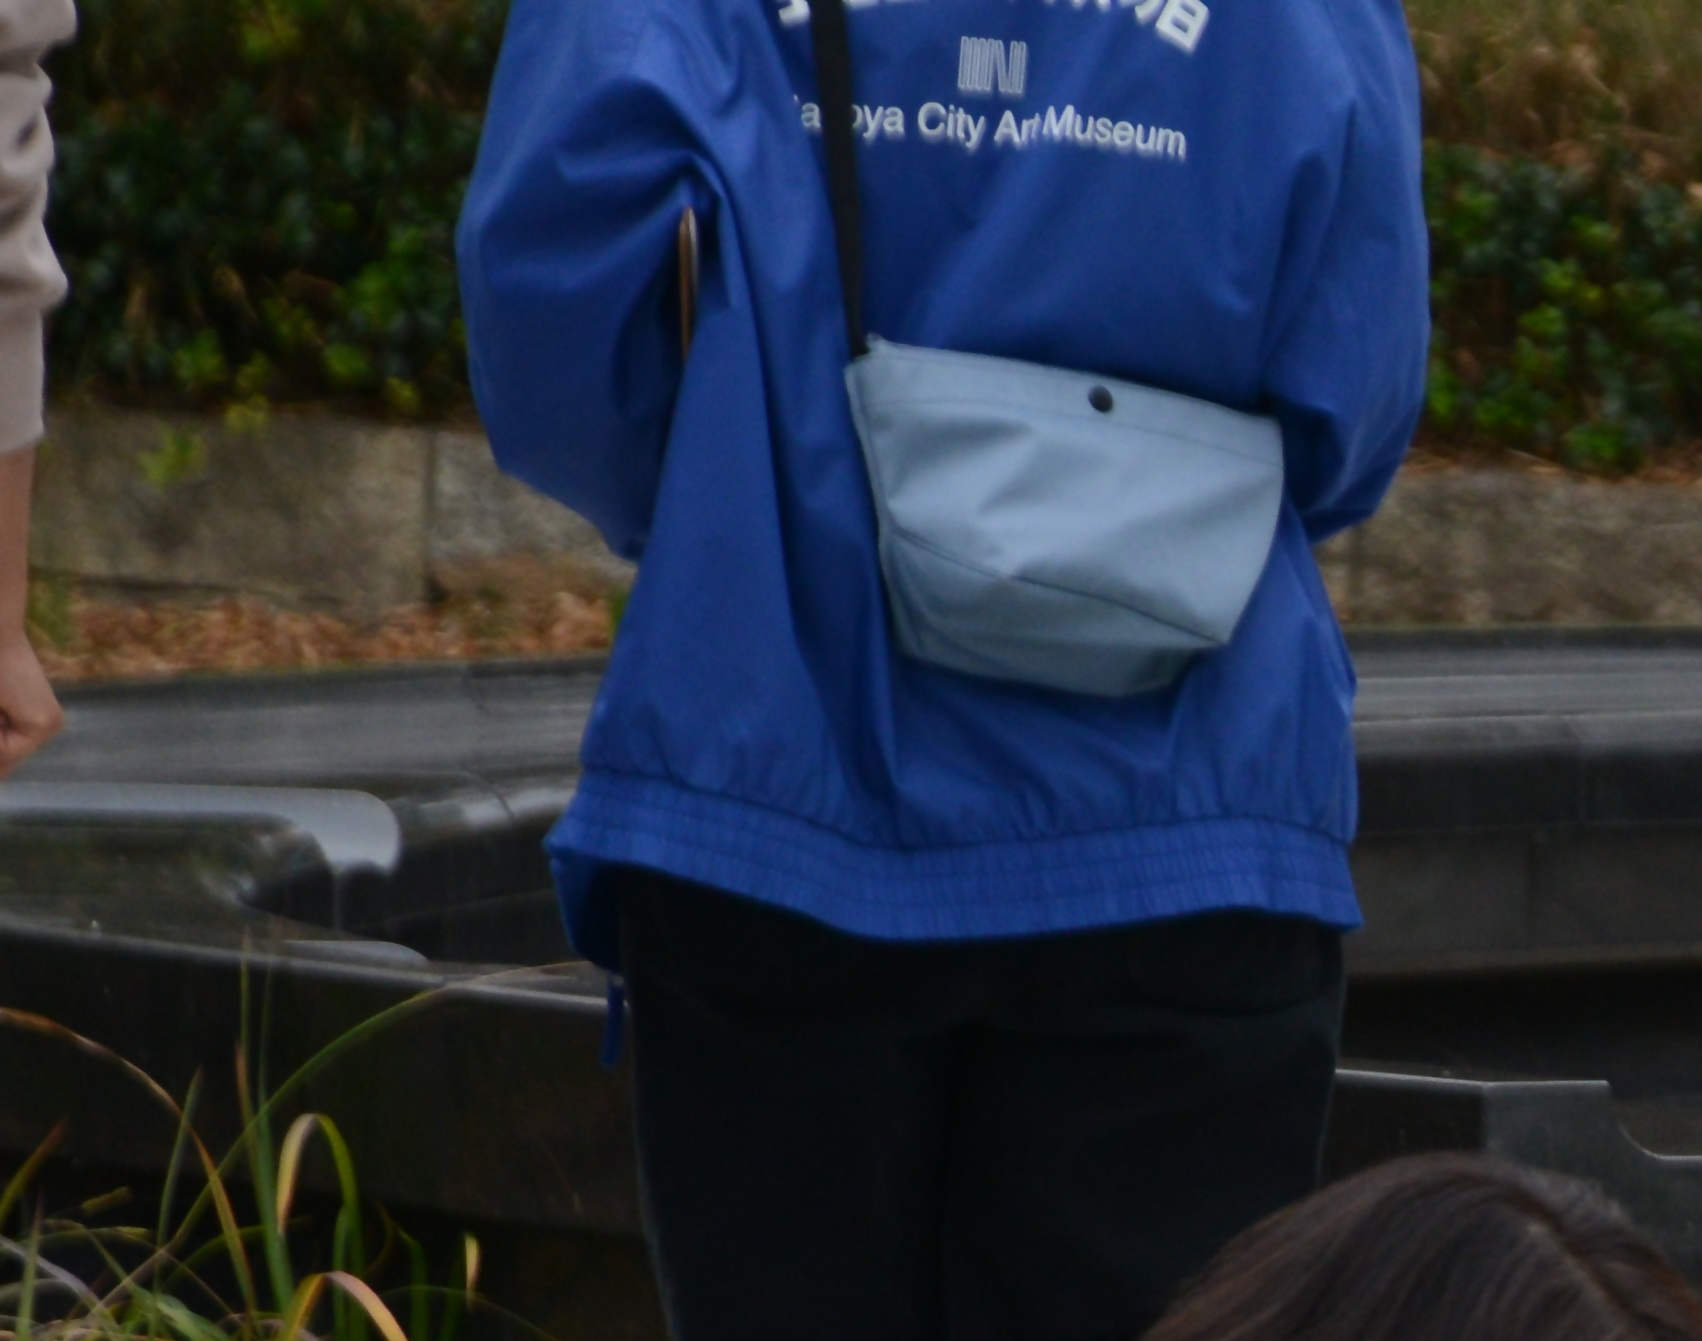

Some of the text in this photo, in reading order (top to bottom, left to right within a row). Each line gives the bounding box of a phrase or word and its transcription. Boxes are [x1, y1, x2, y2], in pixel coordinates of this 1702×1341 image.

[917, 101, 985, 148] City
[994, 109, 1041, 143] Art
[1042, 104, 1186, 156] Museum
